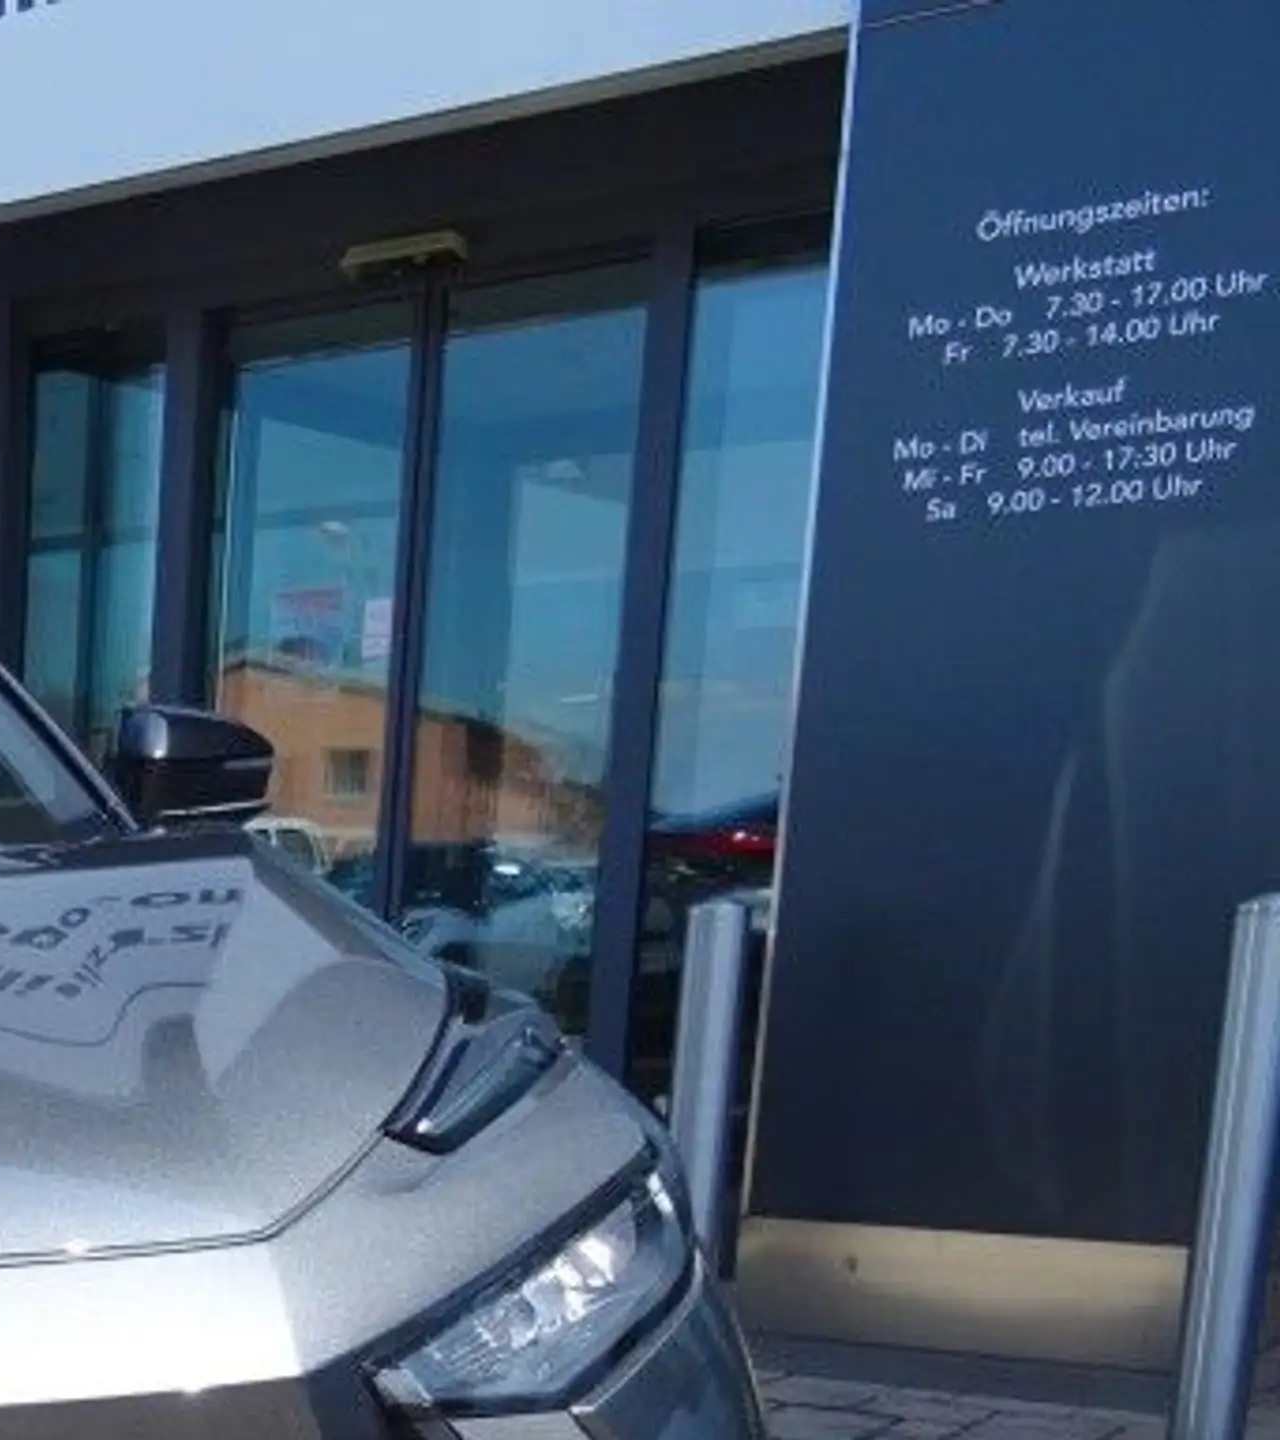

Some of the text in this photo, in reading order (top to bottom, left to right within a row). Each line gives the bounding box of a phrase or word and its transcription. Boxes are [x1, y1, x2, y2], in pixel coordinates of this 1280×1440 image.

[976, 188, 1211, 242] Öffnungszeiten:
[1013, 251, 1157, 289] Werkstatt
[907, 315, 951, 341] Mo
[975, 306, 1014, 330] Do
[1045, 291, 1105, 320] 7.30
[1131, 277, 1206, 308] 17.00
[1215, 269, 1270, 298] Uhr
[942, 340, 974, 365] Fr
[1000, 329, 1061, 359] 7.30
[1086, 316, 1162, 347] 14.00
[1168, 310, 1222, 336] Uhr
[1017, 377, 1130, 414] Verkauf
[892, 434, 937, 462] Mo
[1018, 424, 1062, 449] tel.
[1069, 405, 1257, 442] Vereinbarung
[959, 463, 989, 487] Fr
[1016, 453, 1077, 481] 9.00
[1185, 435, 1238, 464] Uhr
[925, 496, 957, 523] Sa
[987, 488, 1047, 516] 9.00
[1071, 479, 1145, 509] 12.00
[1152, 473, 1204, 501] Uhr
